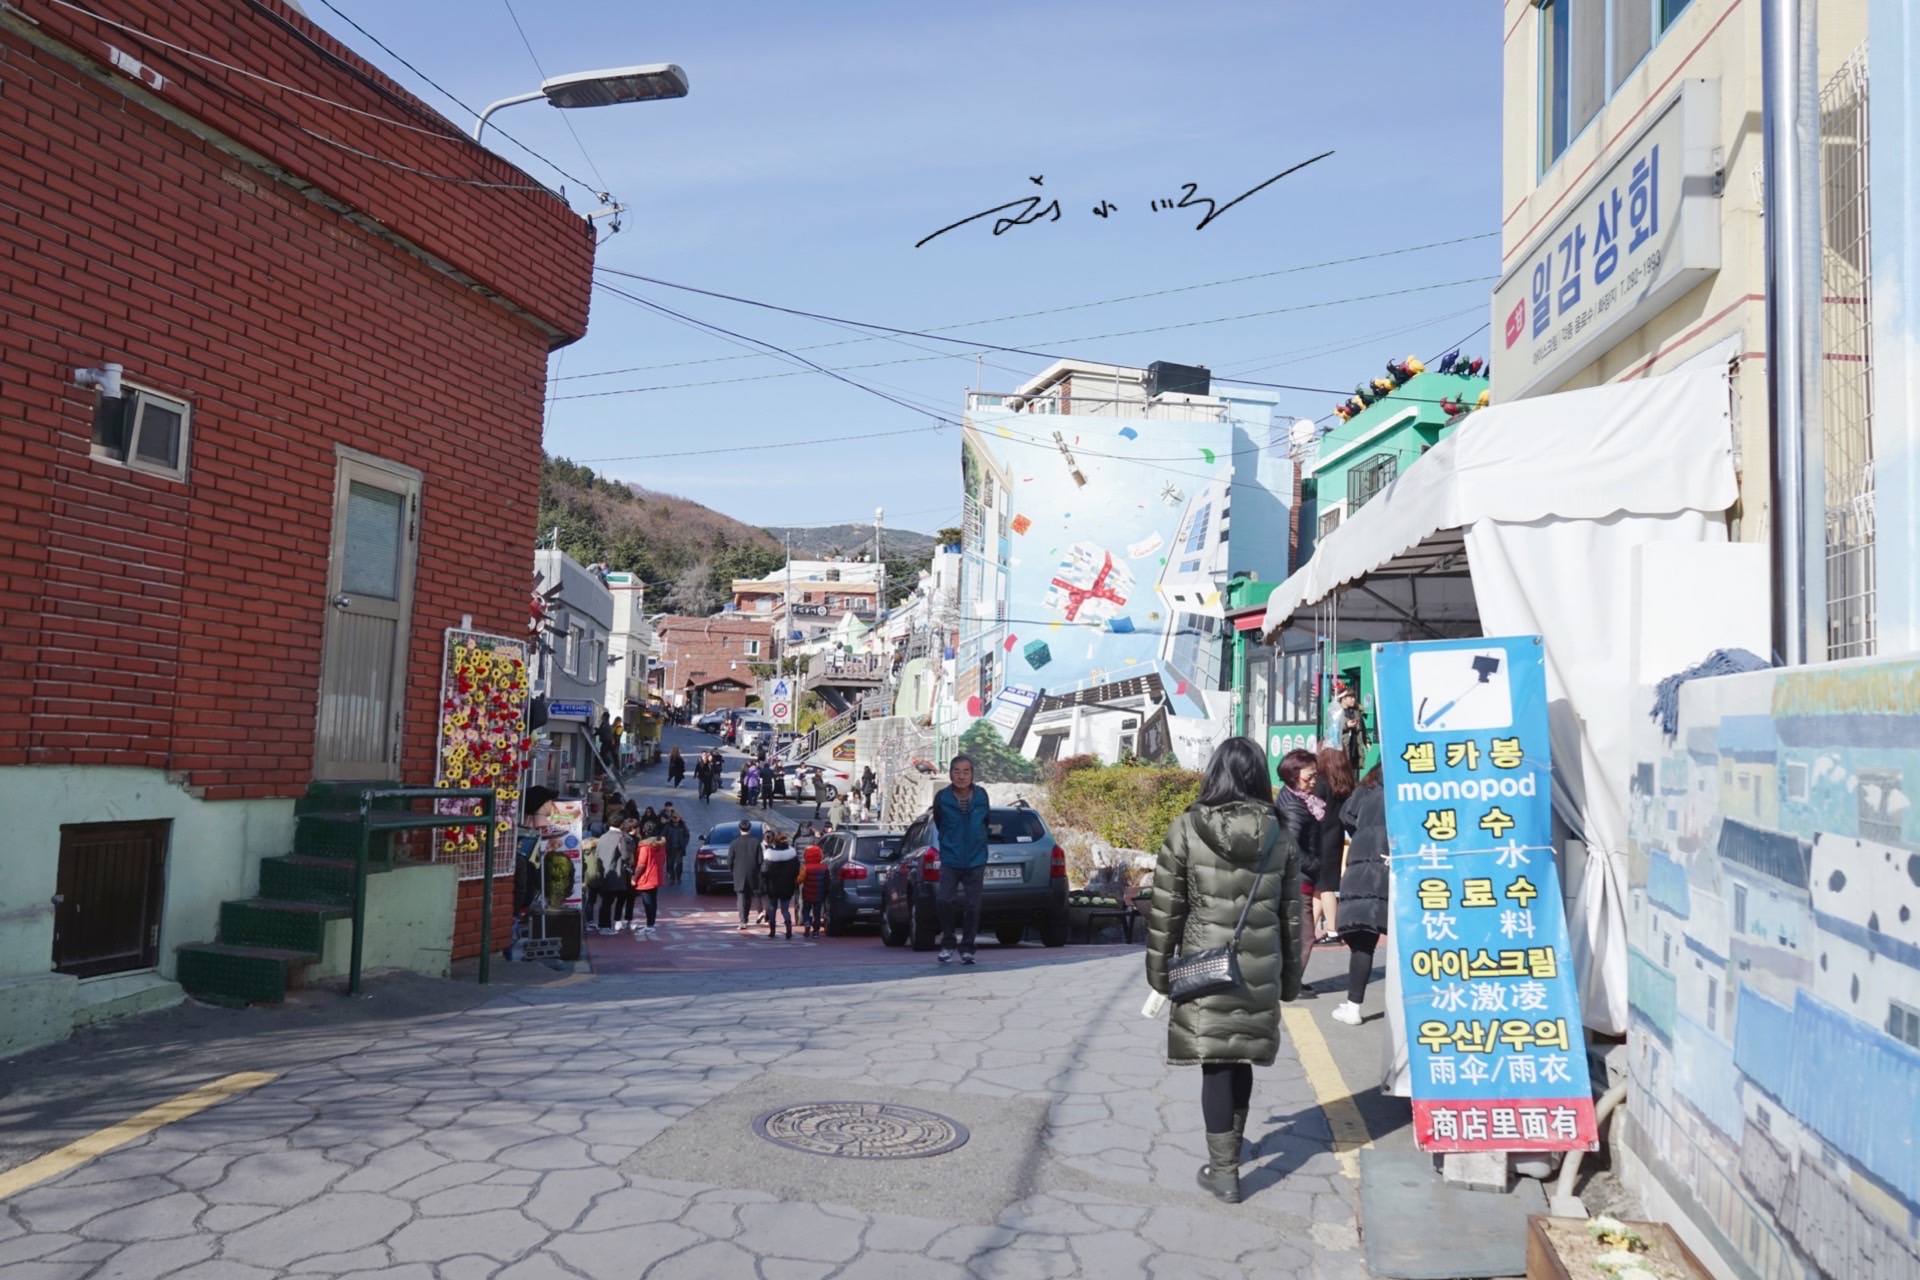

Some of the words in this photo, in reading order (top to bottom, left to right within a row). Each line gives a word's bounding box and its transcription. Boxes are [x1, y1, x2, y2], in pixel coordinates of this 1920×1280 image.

[1532, 143, 1660, 341] 일감상회
[1398, 772, 1536, 802] monopod
[997, 868, 1018, 877] 7113
[1412, 946, 1558, 981] 아이스크림
[1431, 981, 1549, 1012] 冰激凌
[1417, 1018, 1570, 1053] 우산/우의
[1427, 1053, 1573, 1086] 雨伞/雨衣
[1430, 1105, 1579, 1142] 商店里面有
